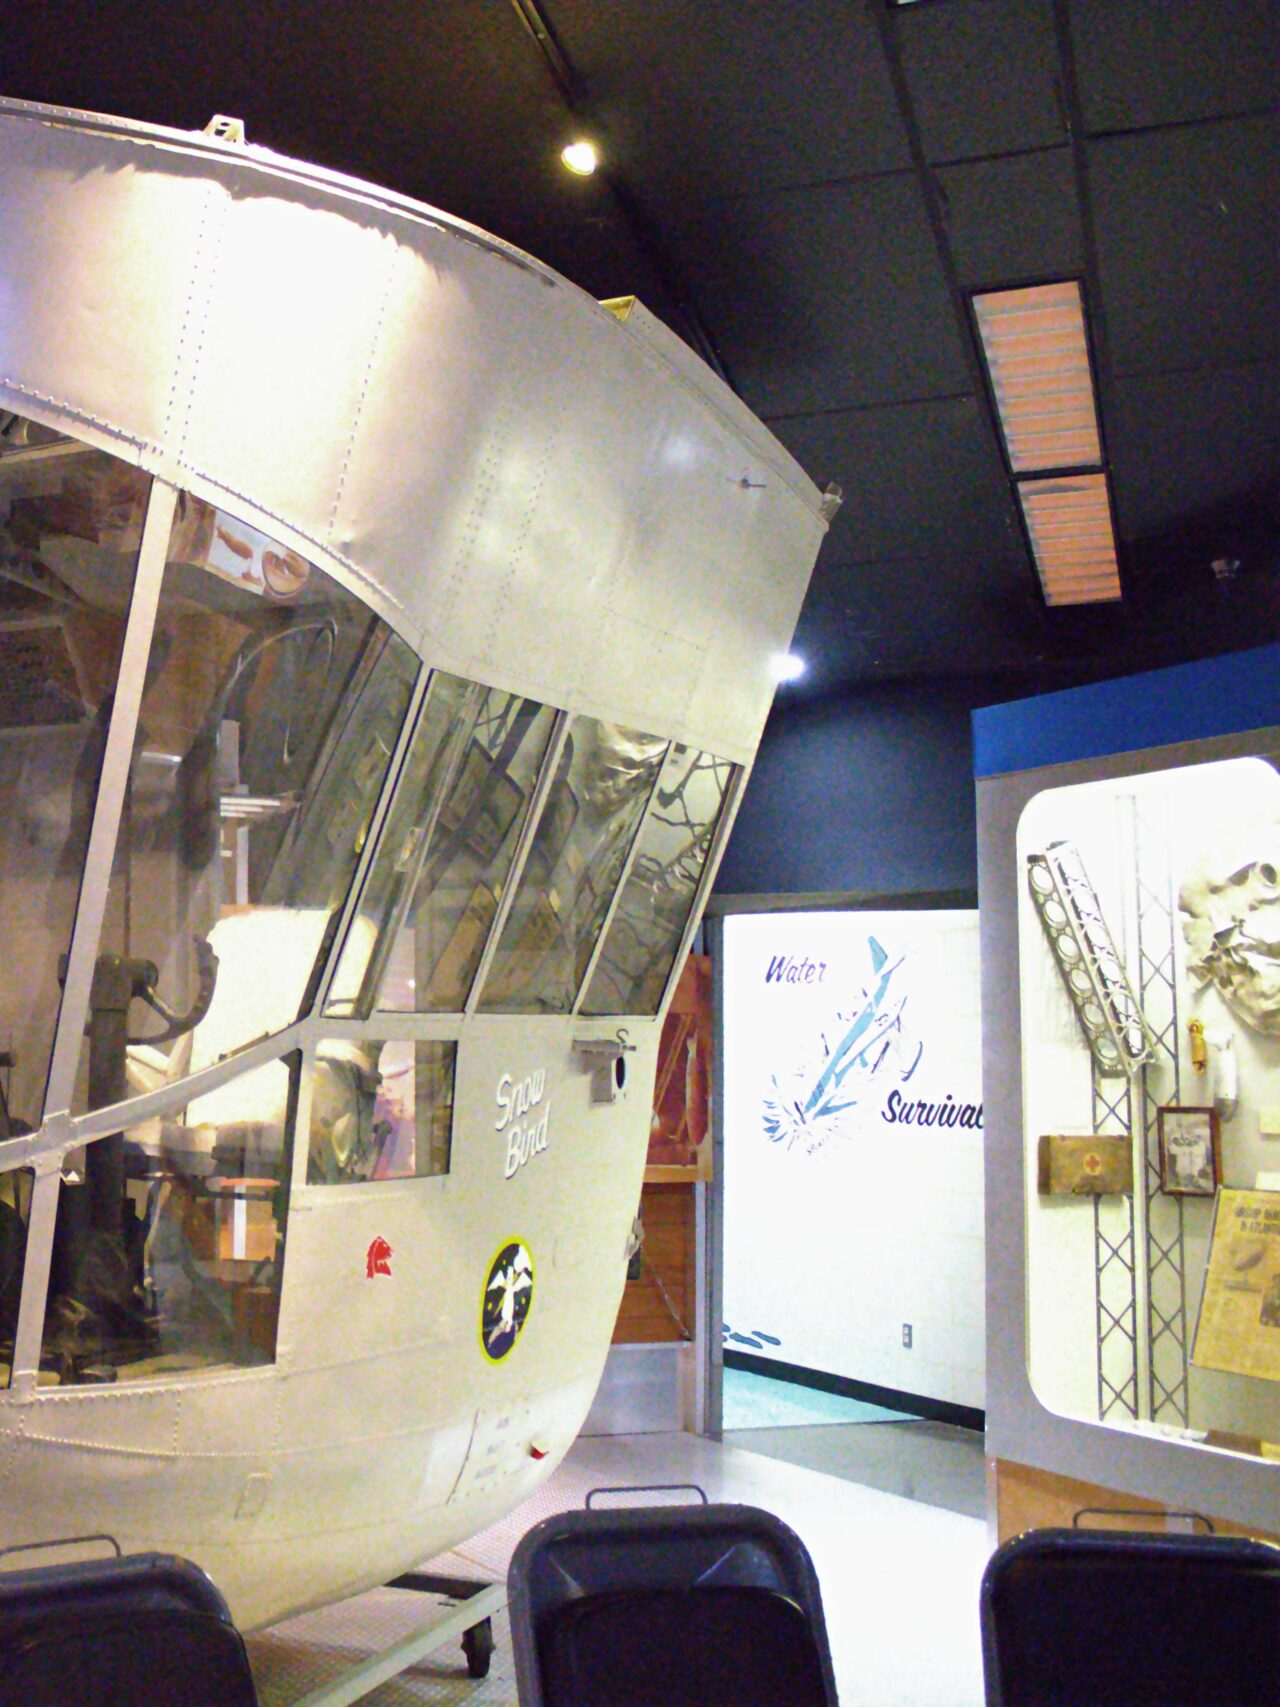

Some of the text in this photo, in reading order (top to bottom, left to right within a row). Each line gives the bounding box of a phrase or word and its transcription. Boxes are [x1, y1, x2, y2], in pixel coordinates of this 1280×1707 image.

[765, 955, 827, 984] Water
[495, 1068, 546, 1132] Snow
[505, 1100, 551, 1180] Bird
